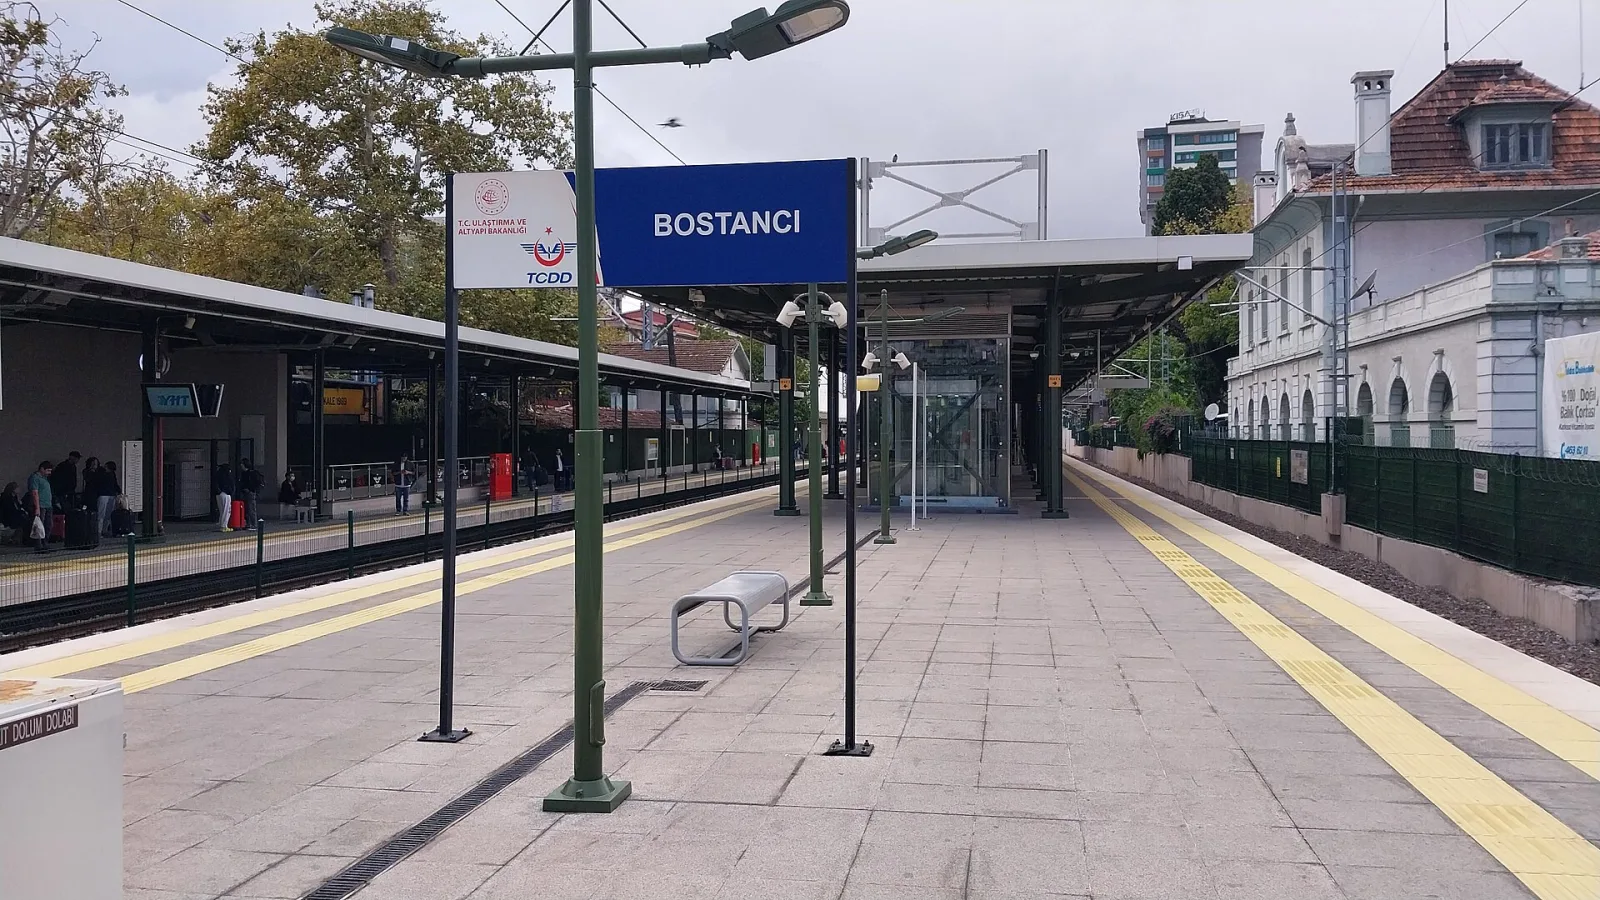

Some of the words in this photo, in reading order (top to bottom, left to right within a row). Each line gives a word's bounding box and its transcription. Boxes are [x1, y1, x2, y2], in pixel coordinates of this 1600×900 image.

[472, 219, 515, 227] ULAŞTIRMA
[654, 209, 800, 237] BOSTANCI
[488, 226, 527, 235] BAKANLIĞI
[526, 272, 573, 284] TCDD
[12, 716, 43, 742] DOLUM
[46, 707, 75, 732] DOLABI
